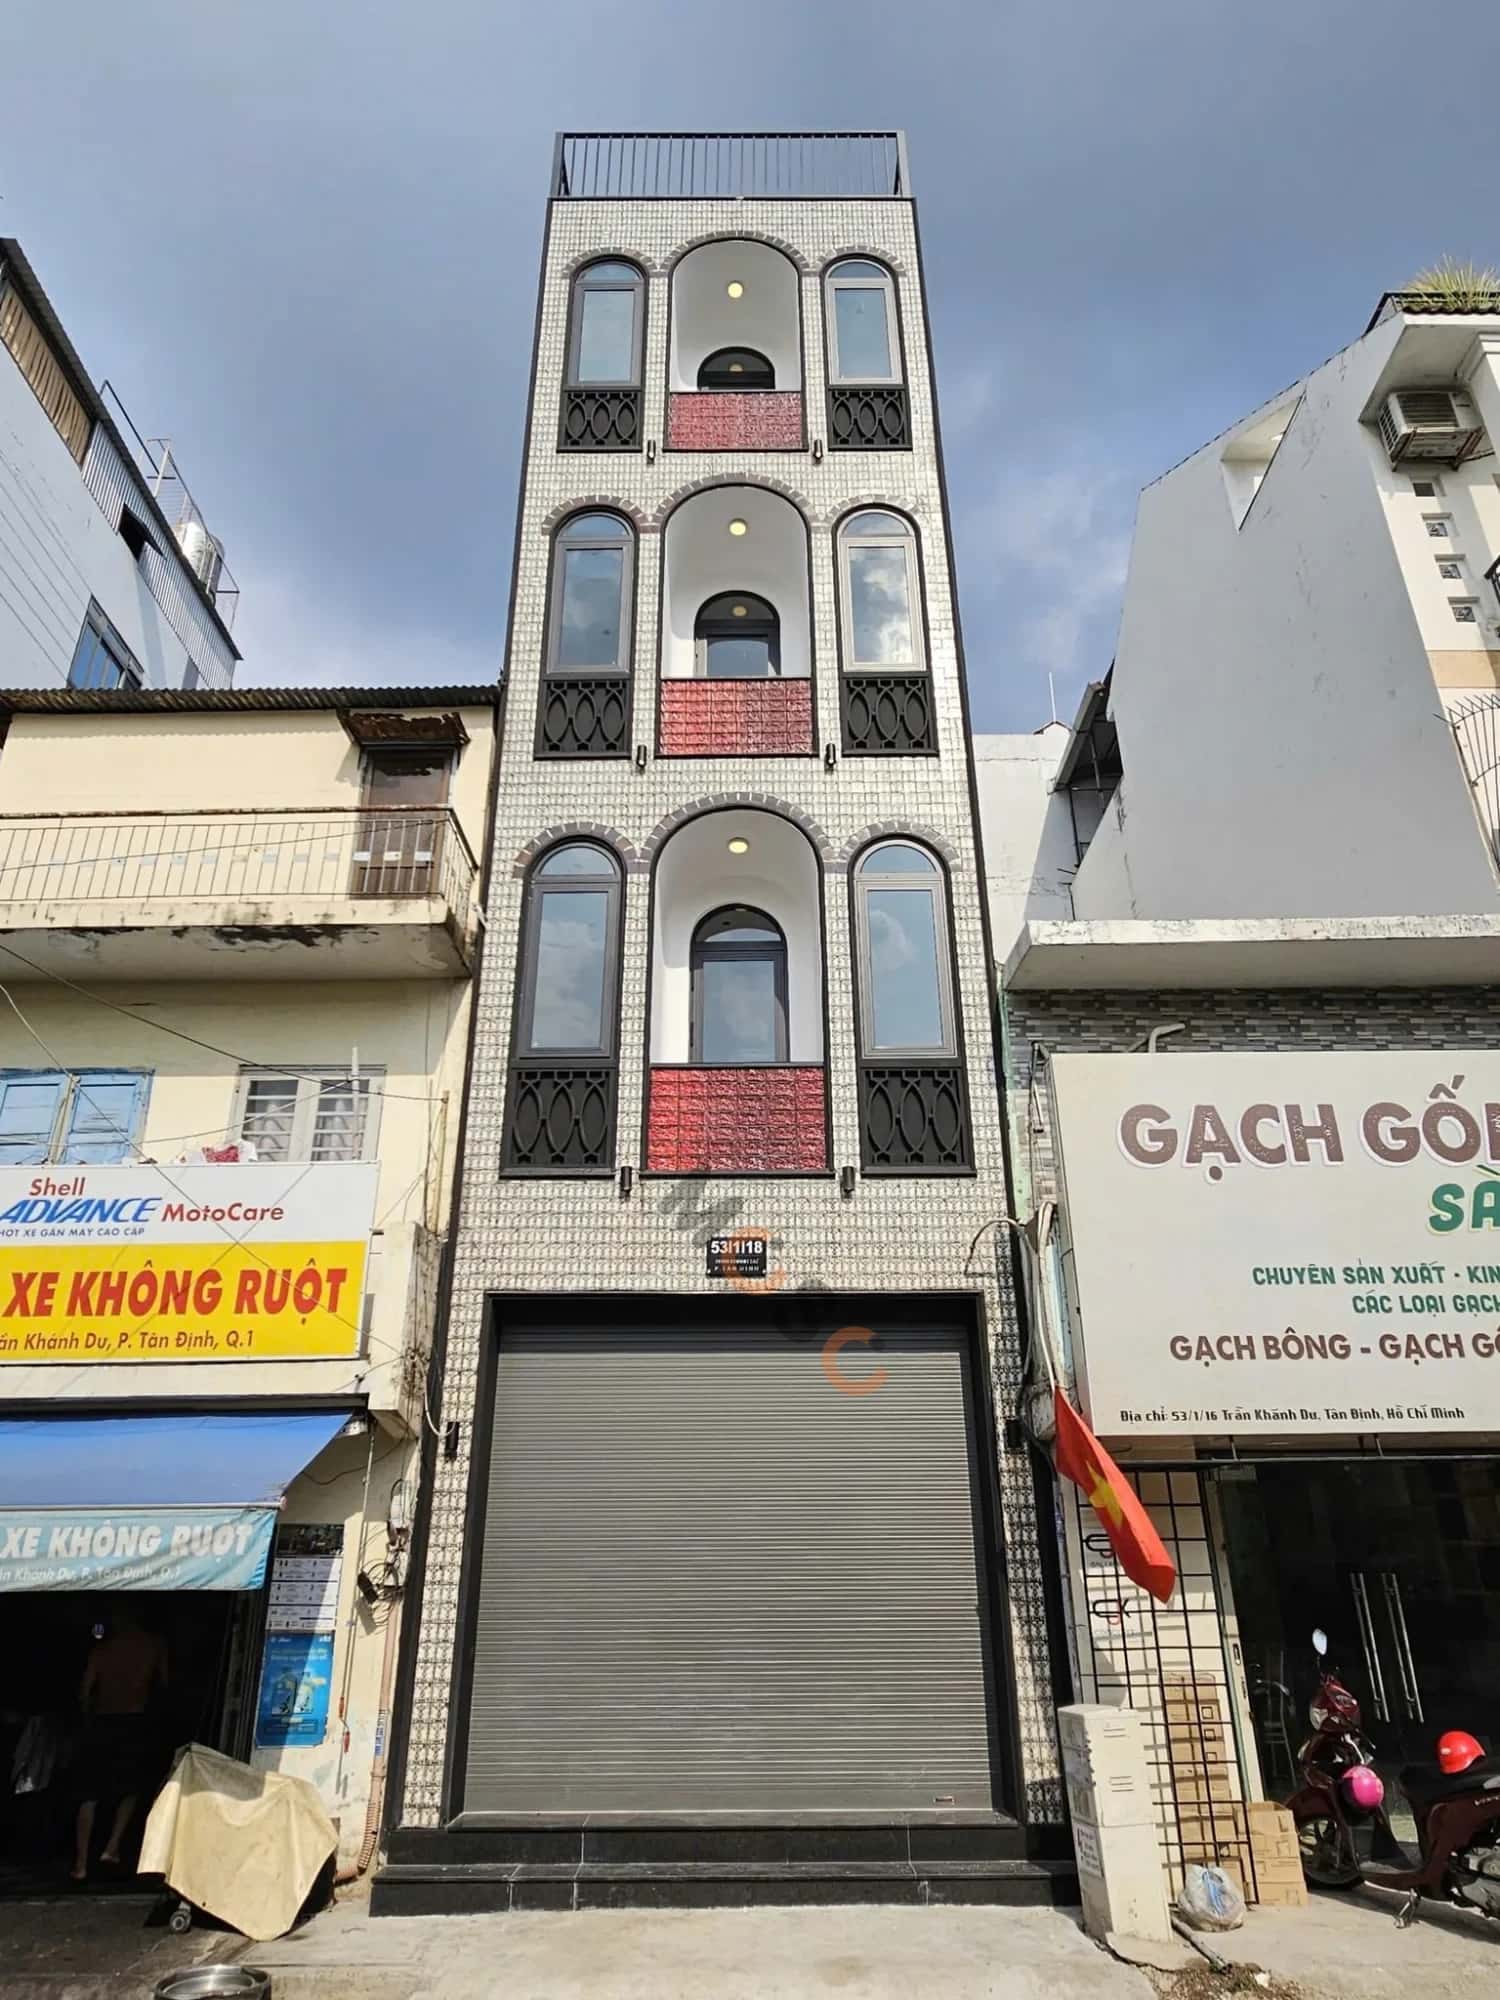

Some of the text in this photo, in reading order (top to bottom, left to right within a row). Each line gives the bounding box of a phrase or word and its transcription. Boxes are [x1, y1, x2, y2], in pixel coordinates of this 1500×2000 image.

[1118, 1075, 1500, 1182] GẠCH GỐ
[29, 1176, 86, 1197] Shell
[0, 1197, 284, 1224] ADVANCE MotoCare
[1252, 1264, 1336, 1285] CHUYÊN
[1391, 1260, 1446, 1284] XUẤT
[2, 1257, 348, 1325] XE KHÔNG RUỘT
[1352, 1289, 1394, 1314] CÁC
[1399, 1295, 1447, 1317] LOẠI
[24, 1331, 79, 1350] Khánh
[1169, 1335, 1257, 1367] GẠCH
[1262, 1326, 1352, 1361] BÔNG
[1378, 1333, 1466, 1366] GẠCH
[1431, 1407, 1465, 1420] Minh
[3, 1526, 43, 1558] XE
[48, 1519, 163, 1559] KHÔNG
